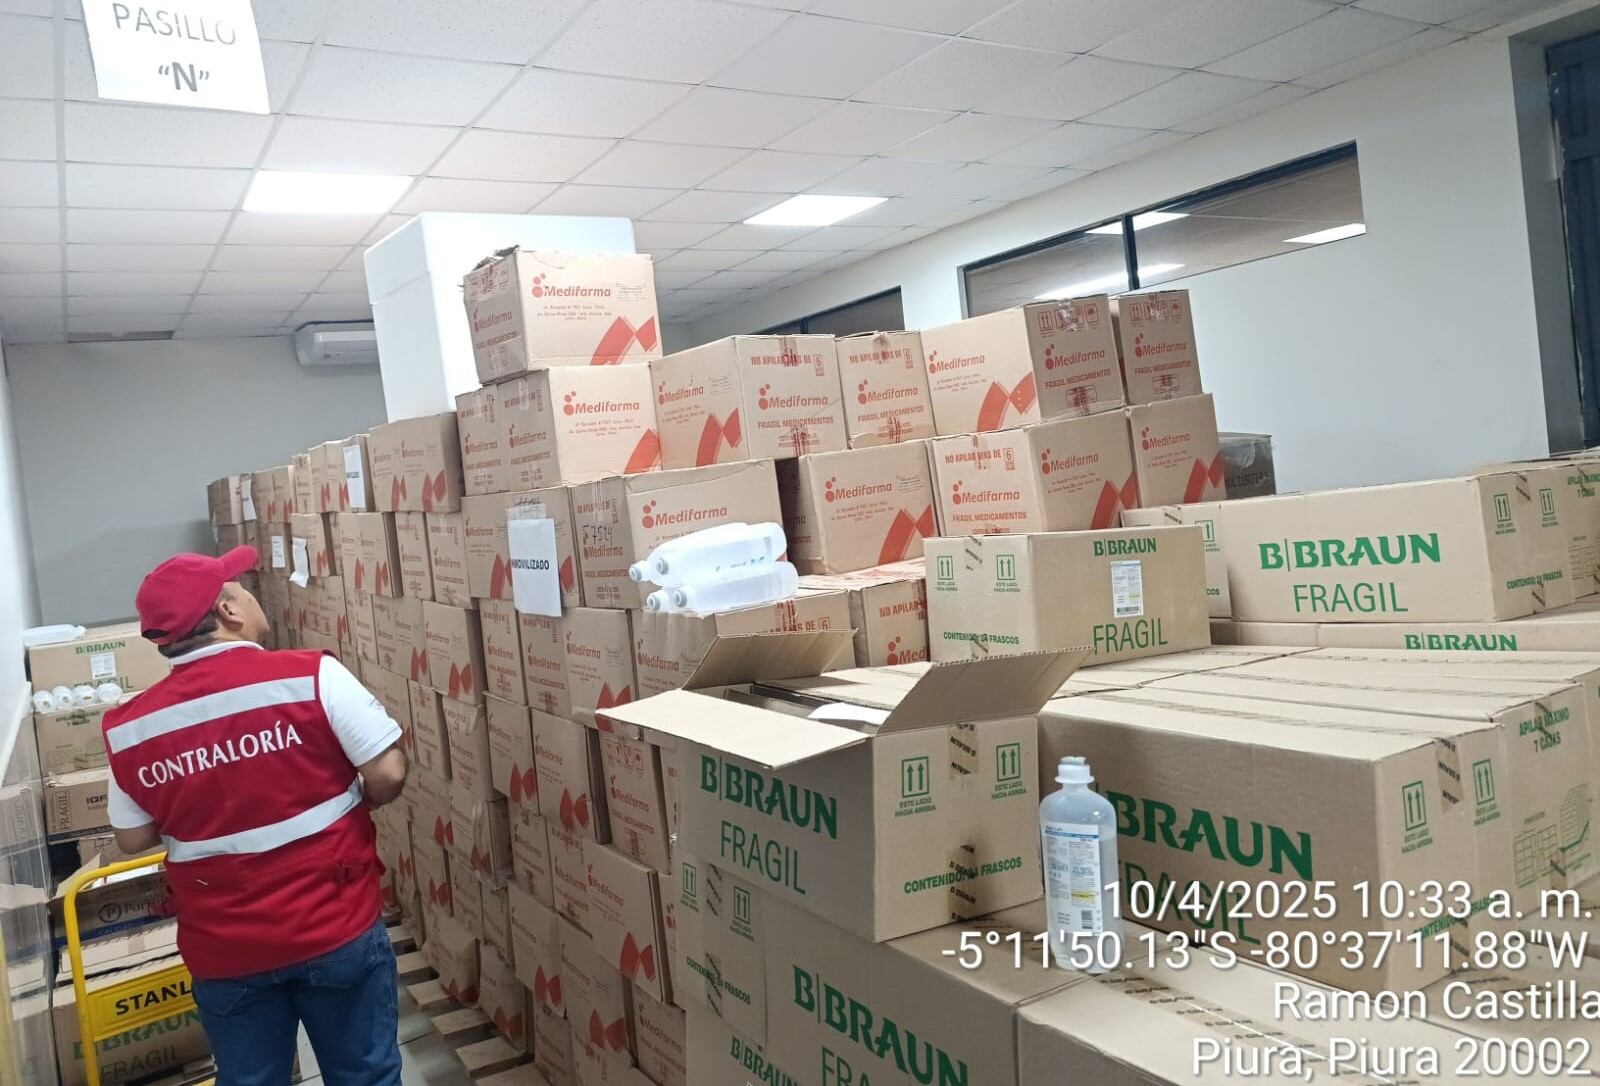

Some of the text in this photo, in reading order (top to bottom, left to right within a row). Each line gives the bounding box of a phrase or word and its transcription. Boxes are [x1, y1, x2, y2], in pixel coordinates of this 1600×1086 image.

[113, 3, 236, 45] PASILLO
[544, 285, 611, 297] Medifarma
[1143, 341, 1186, 357] Medifarma
[937, 353, 985, 371] Medifarma
[1055, 350, 1104, 367] Medifarma
[769, 395, 828, 409] Medifarma
[868, 387, 918, 402] Medifarma
[575, 401, 640, 414] Medifarma
[1149, 432, 1190, 449] Medifarma
[1050, 453, 1099, 472] Medifarma
[835, 481, 893, 500] Medifarma
[962, 490, 1020, 504] Medifarma
[654, 506, 728, 526] Medifarma
[975, 511, 1027, 521] MEDICAMENTOS
[1293, 581, 1409, 613] FRAGIL
[879, 606, 891, 617] NO
[989, 634, 1020, 645] FRASCOS
[1093, 617, 1168, 654] FRAGIL
[138, 719, 304, 788] CONTRALORÍA
[899, 801, 915, 809] ESTE
[720, 820, 806, 895] FRAGIL
[980, 857, 1023, 877] FRASCOS
